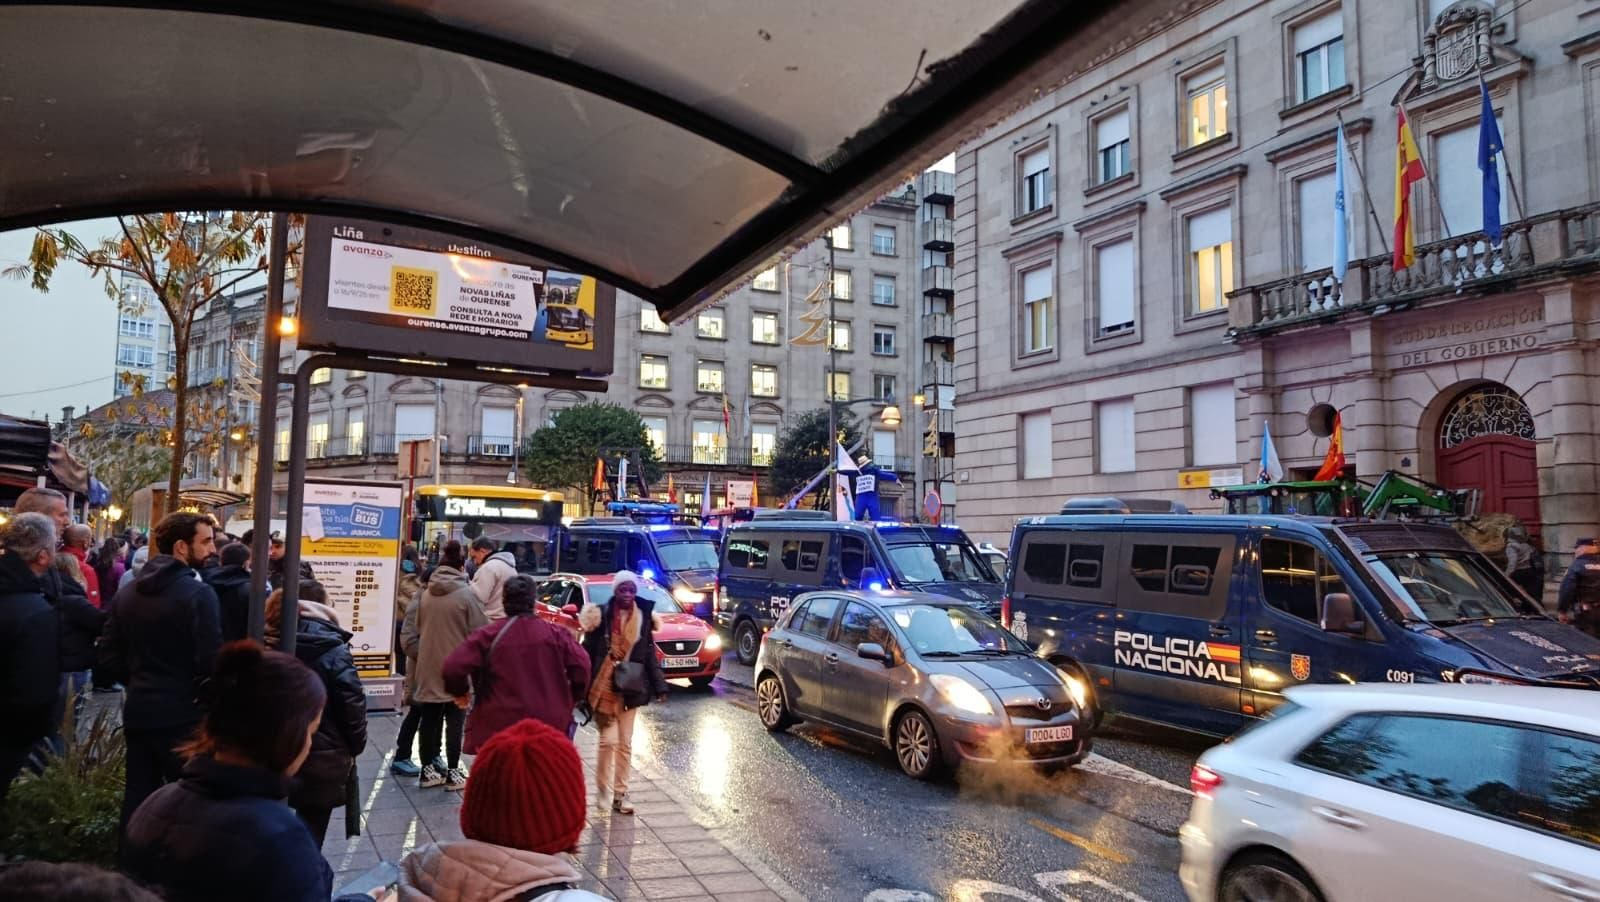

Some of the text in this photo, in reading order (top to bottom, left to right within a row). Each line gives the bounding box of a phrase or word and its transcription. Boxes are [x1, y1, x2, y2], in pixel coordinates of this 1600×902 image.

[333, 225, 364, 240] Liña
[343, 245, 383, 257] avanza
[459, 286, 516, 301] NOVAS LIÑAS
[470, 296, 511, 308] OURENSE
[449, 305, 522, 321] CONSULTA A NOVA
[449, 311, 470, 321] REDE
[477, 315, 519, 327] HORARIOS
[1395, 308, 1543, 344] SUBDELEGACIÓN
[1401, 335, 1537, 367] DEL GOBIERNO
[355, 513, 378, 526] BUS
[1114, 630, 1212, 660] POLICIA
[1114, 649, 1241, 684] NACIONAL
[1386, 669, 1415, 684] C091
